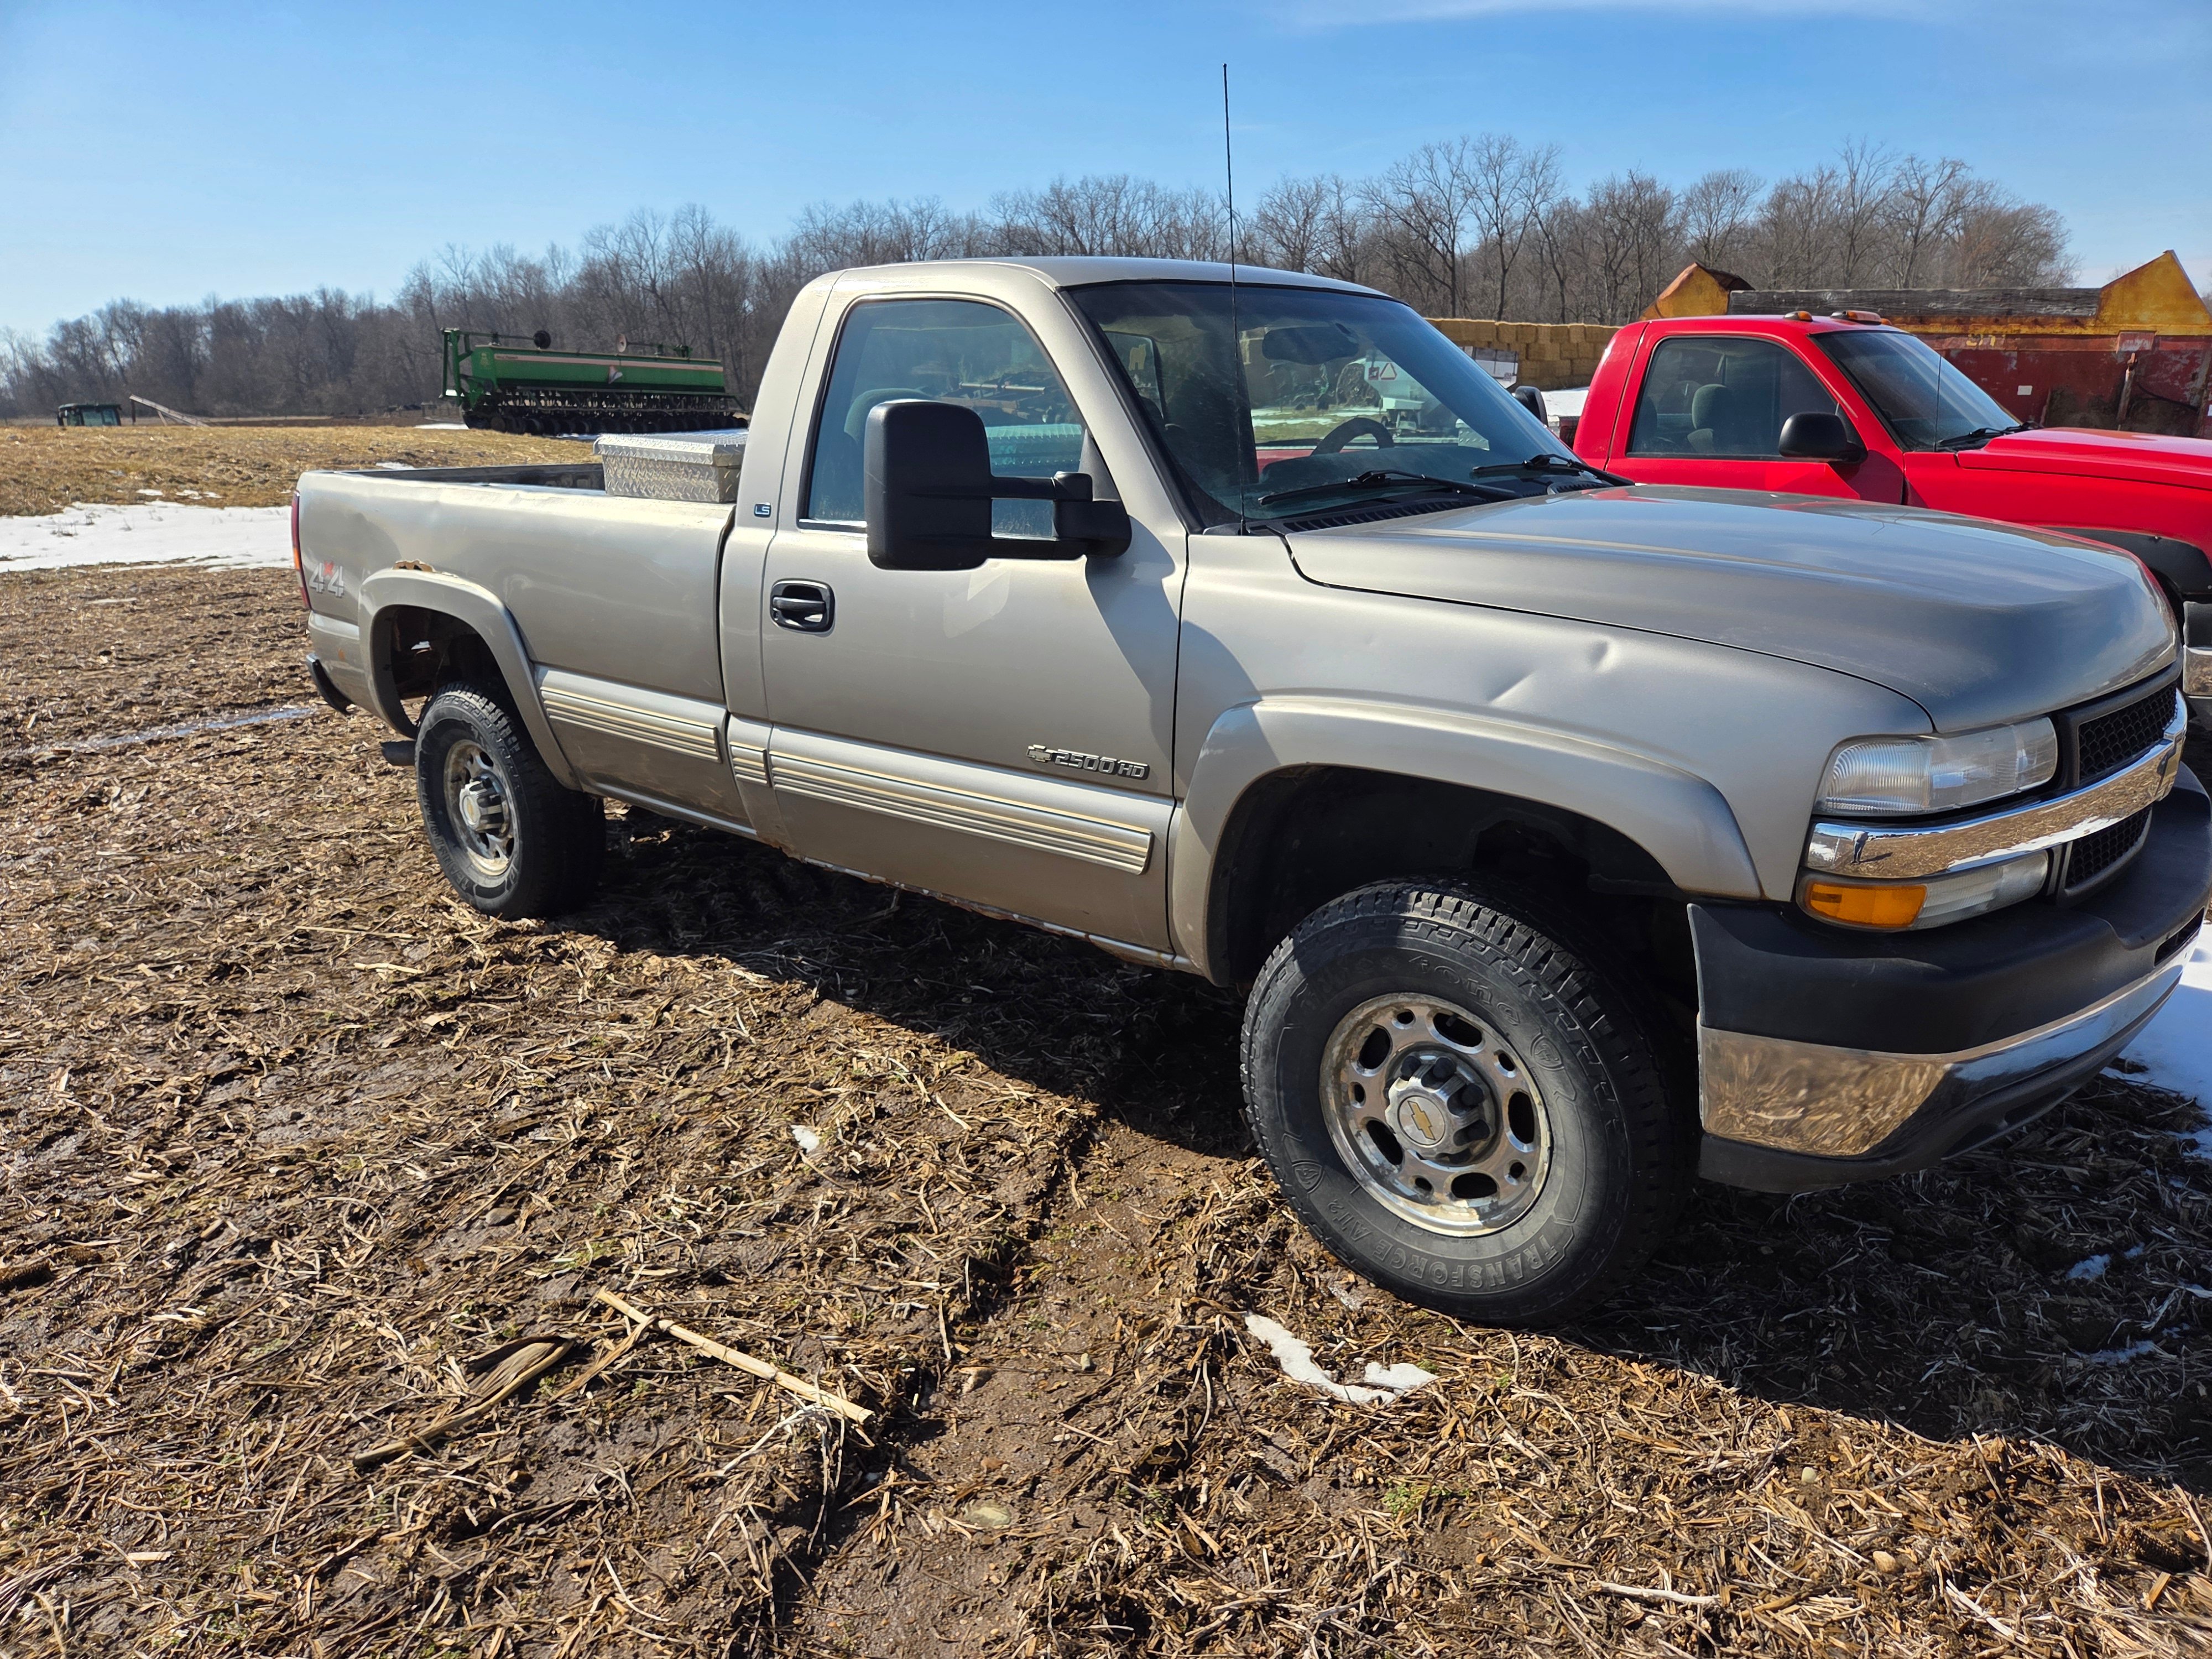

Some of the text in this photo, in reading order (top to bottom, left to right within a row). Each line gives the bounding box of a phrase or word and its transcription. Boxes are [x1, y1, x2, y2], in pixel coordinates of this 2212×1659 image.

[755, 505, 770, 515] LS
[1054, 750, 1145, 778] 2500 HD
[1327, 1199, 1561, 1289] TRANSFORCE AT2
